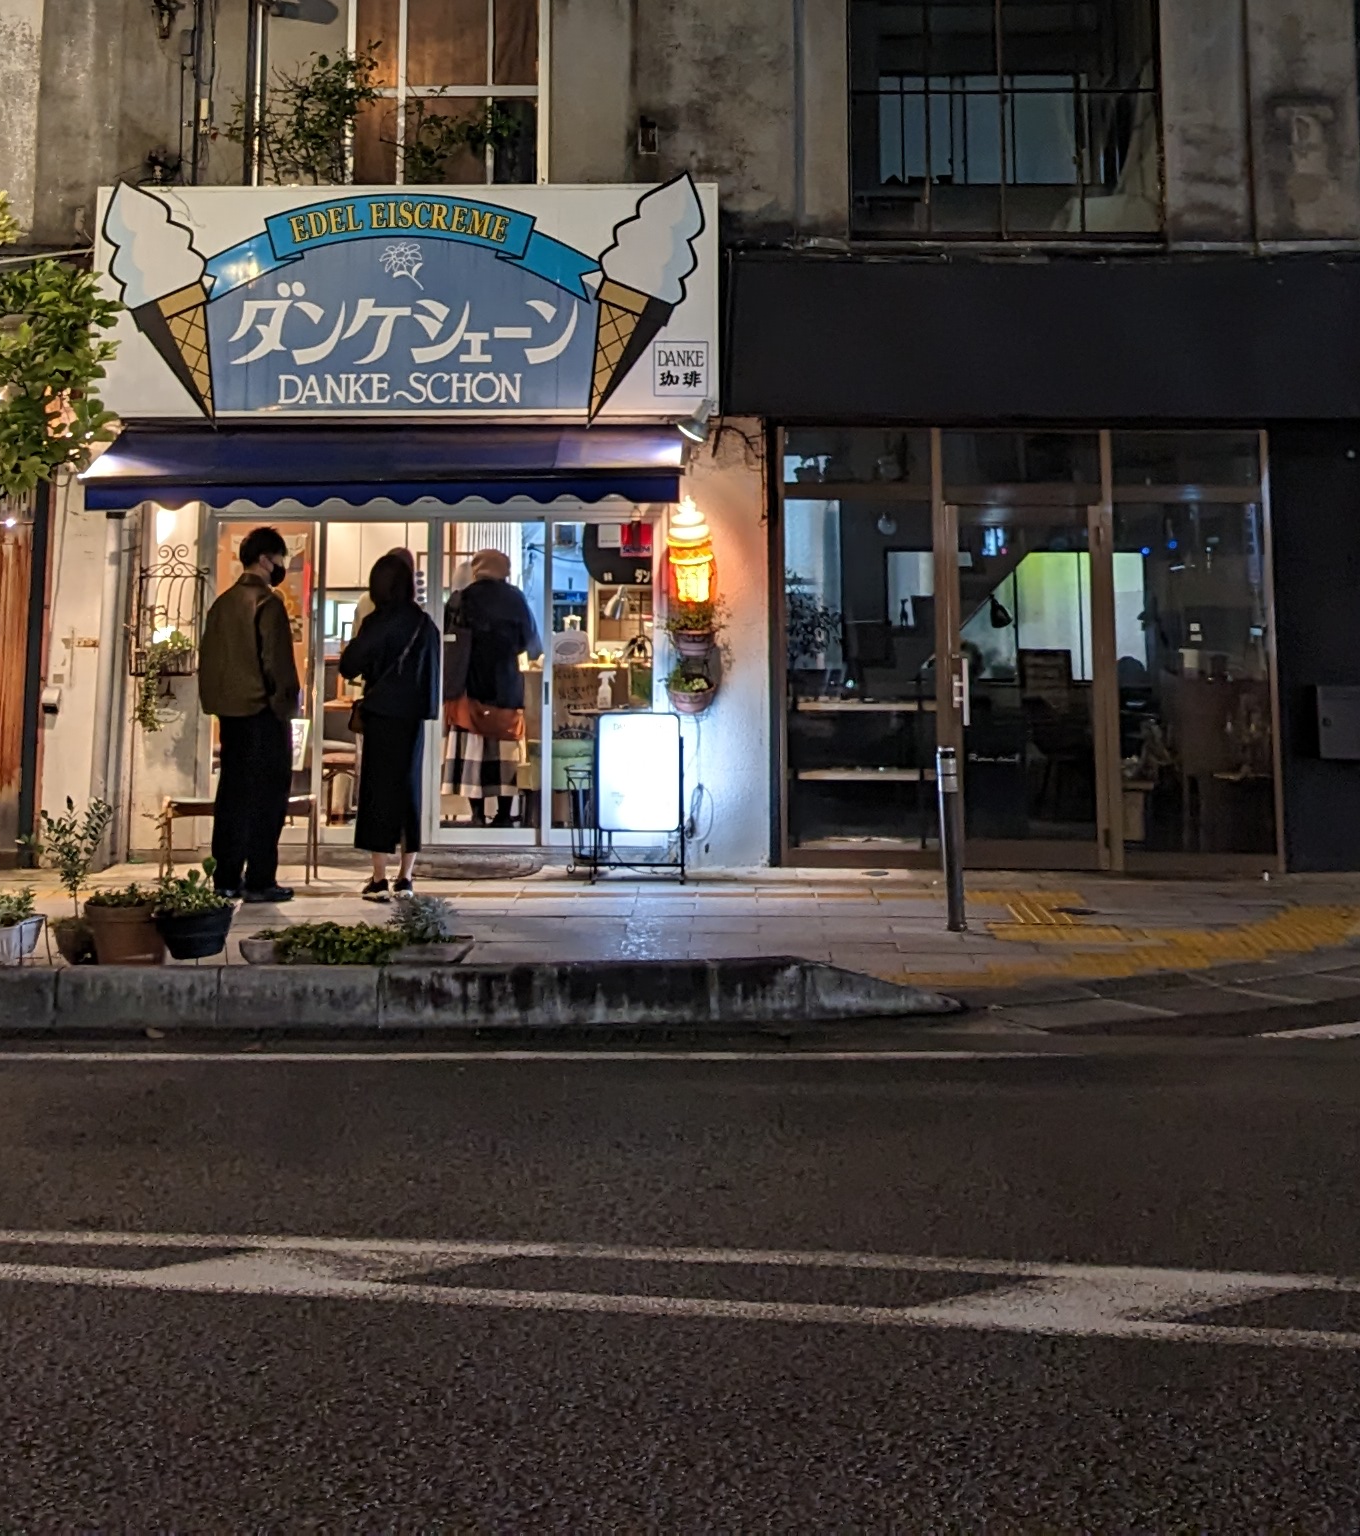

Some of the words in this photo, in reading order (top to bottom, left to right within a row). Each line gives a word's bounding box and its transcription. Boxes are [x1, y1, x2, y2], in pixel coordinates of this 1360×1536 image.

[288, 204, 363, 245] EDEL
[369, 200, 511, 244] EISCREME
[228, 280, 578, 367] ダンケシェーン
[657, 349, 705, 368] DANKE
[277, 372, 391, 405] DANKE
[658, 370, 704, 389] 珈琲
